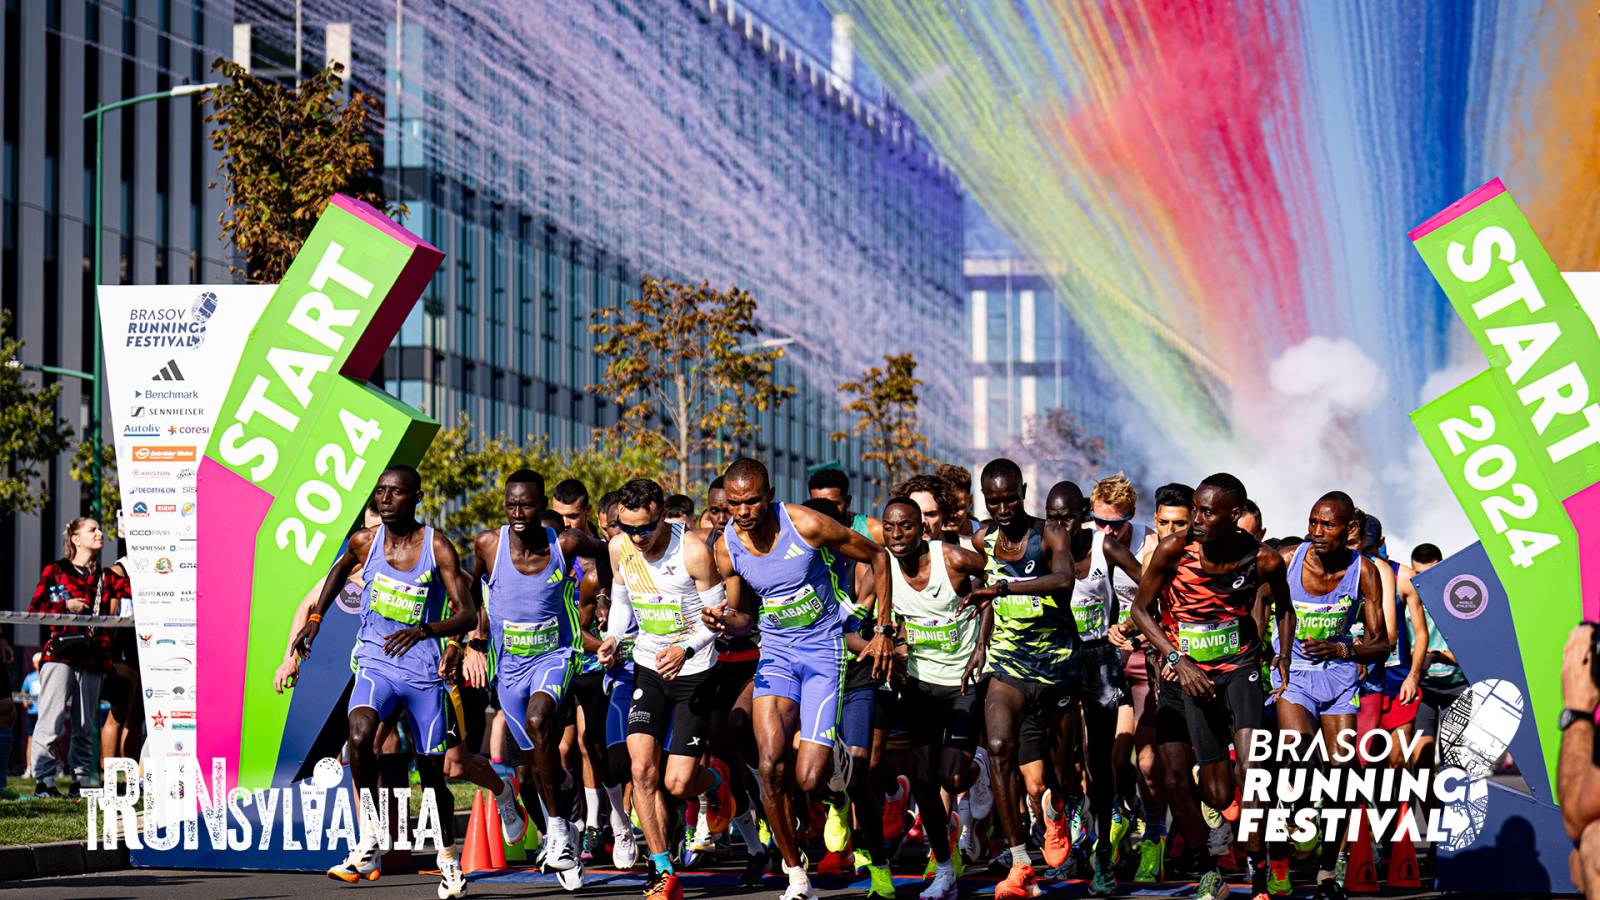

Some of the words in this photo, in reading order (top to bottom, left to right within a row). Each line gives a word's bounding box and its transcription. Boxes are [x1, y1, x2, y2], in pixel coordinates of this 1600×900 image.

[129, 309, 186, 321] BRASOV
[128, 322, 200, 334] RUNNING
[126, 336, 194, 347] FESTIVAL
[1447, 226, 1600, 463] START
[219, 241, 375, 482] START
[145, 390, 199, 399] Benchmark
[124, 424, 161, 432] Autoliv
[275, 407, 383, 566] 2024
[1438, 405, 1561, 568] 2024
[774, 602, 812, 619] LABAN
[1301, 617, 1337, 629] VICTOR
[513, 633, 549, 646] DANIEL
[915, 629, 950, 641] DANIEL
[1192, 635, 1226, 649] DAVID
